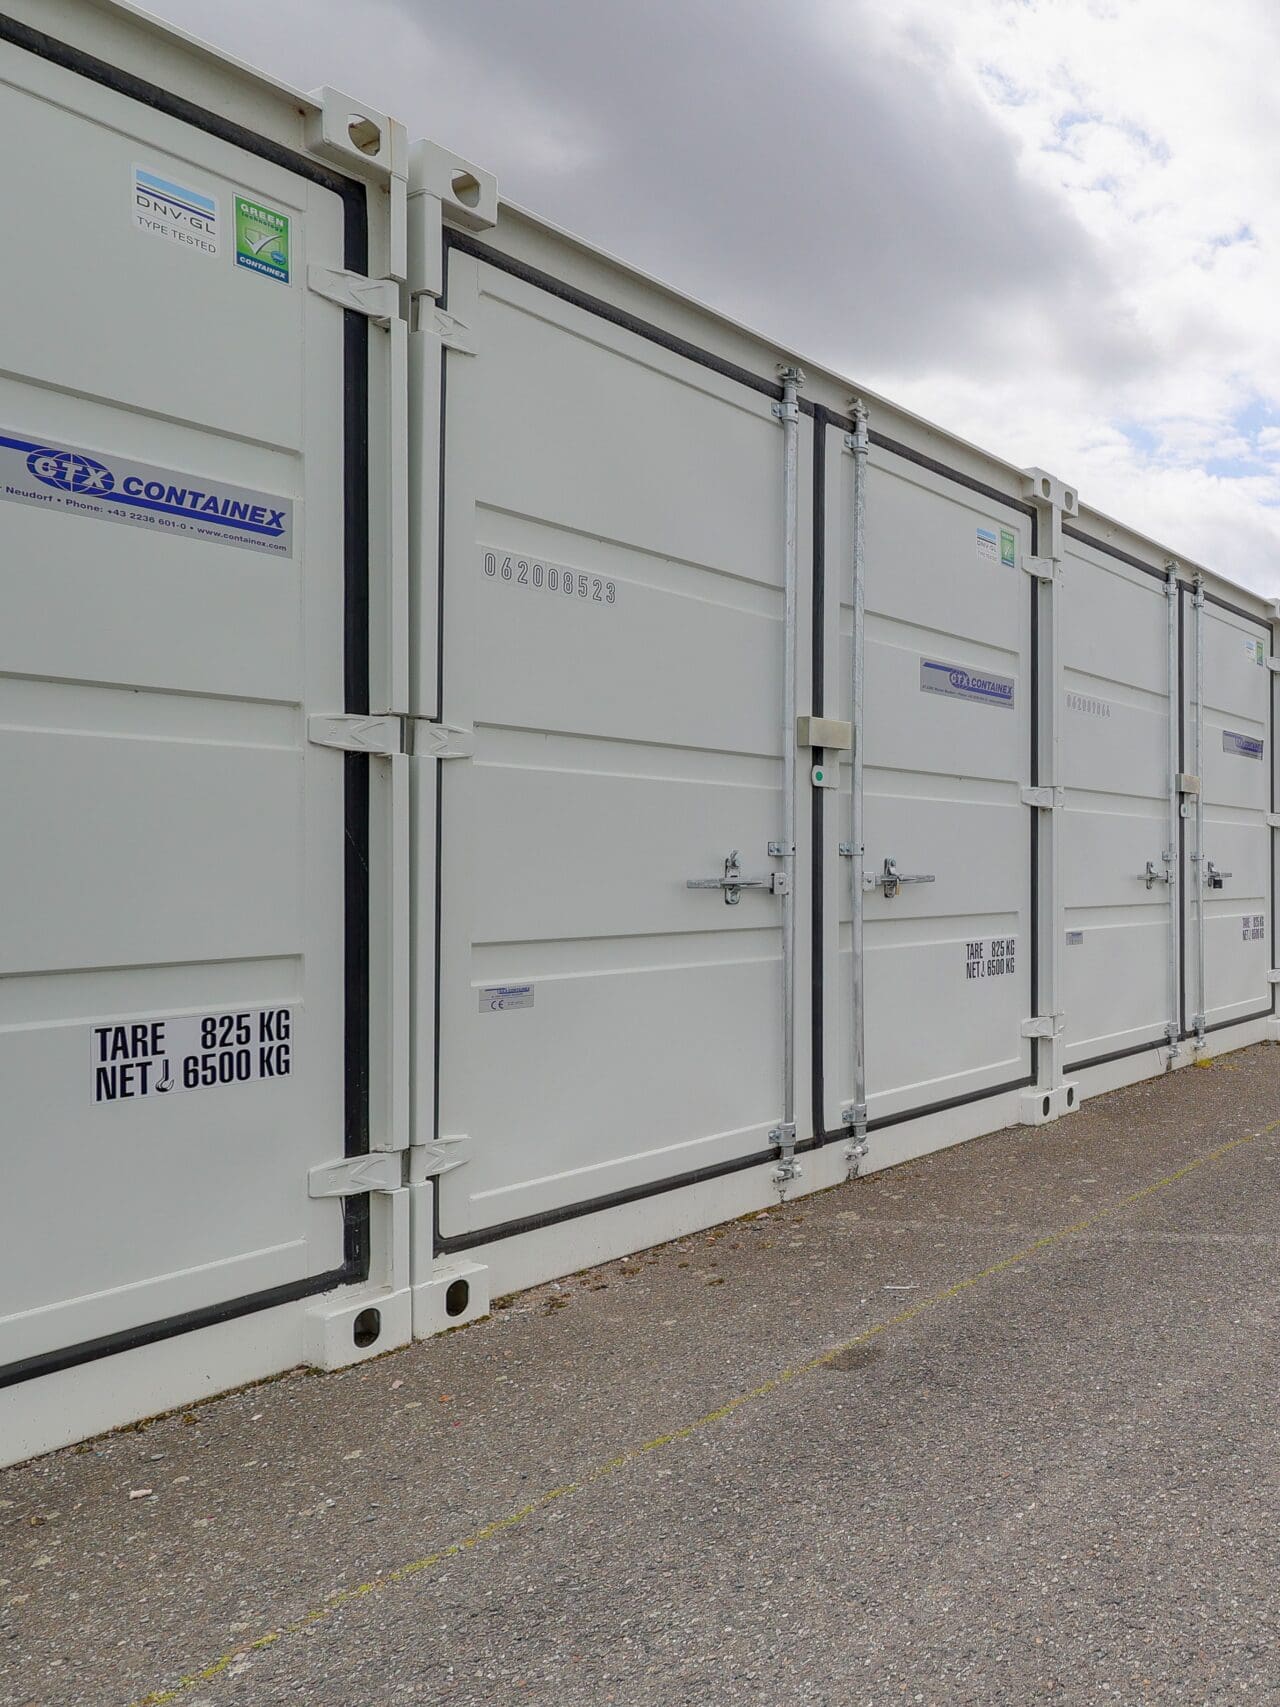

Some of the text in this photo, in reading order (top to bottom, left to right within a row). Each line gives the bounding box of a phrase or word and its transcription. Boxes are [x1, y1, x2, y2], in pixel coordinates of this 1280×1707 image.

[137, 215, 217, 254] TYPE TESTED
[240, 203, 285, 227] GREEN
[239, 256, 287, 279] CONTAINEX
[34, 455, 286, 529] CTX CONTAINEX
[5, 486, 53, 502] Neudorf
[65, 498, 103, 513] Phone:
[196, 527, 287, 552] www.containex.com
[484, 552, 616, 604] 062008523
[971, 677, 1013, 696] CONTAINEX
[966, 939, 1015, 960] TARE 825 KG
[966, 957, 1015, 979] NET 6500 KG
[95, 1008, 291, 1062] TARE 825 KG
[95, 1043, 291, 1102] NET 6500 KG
